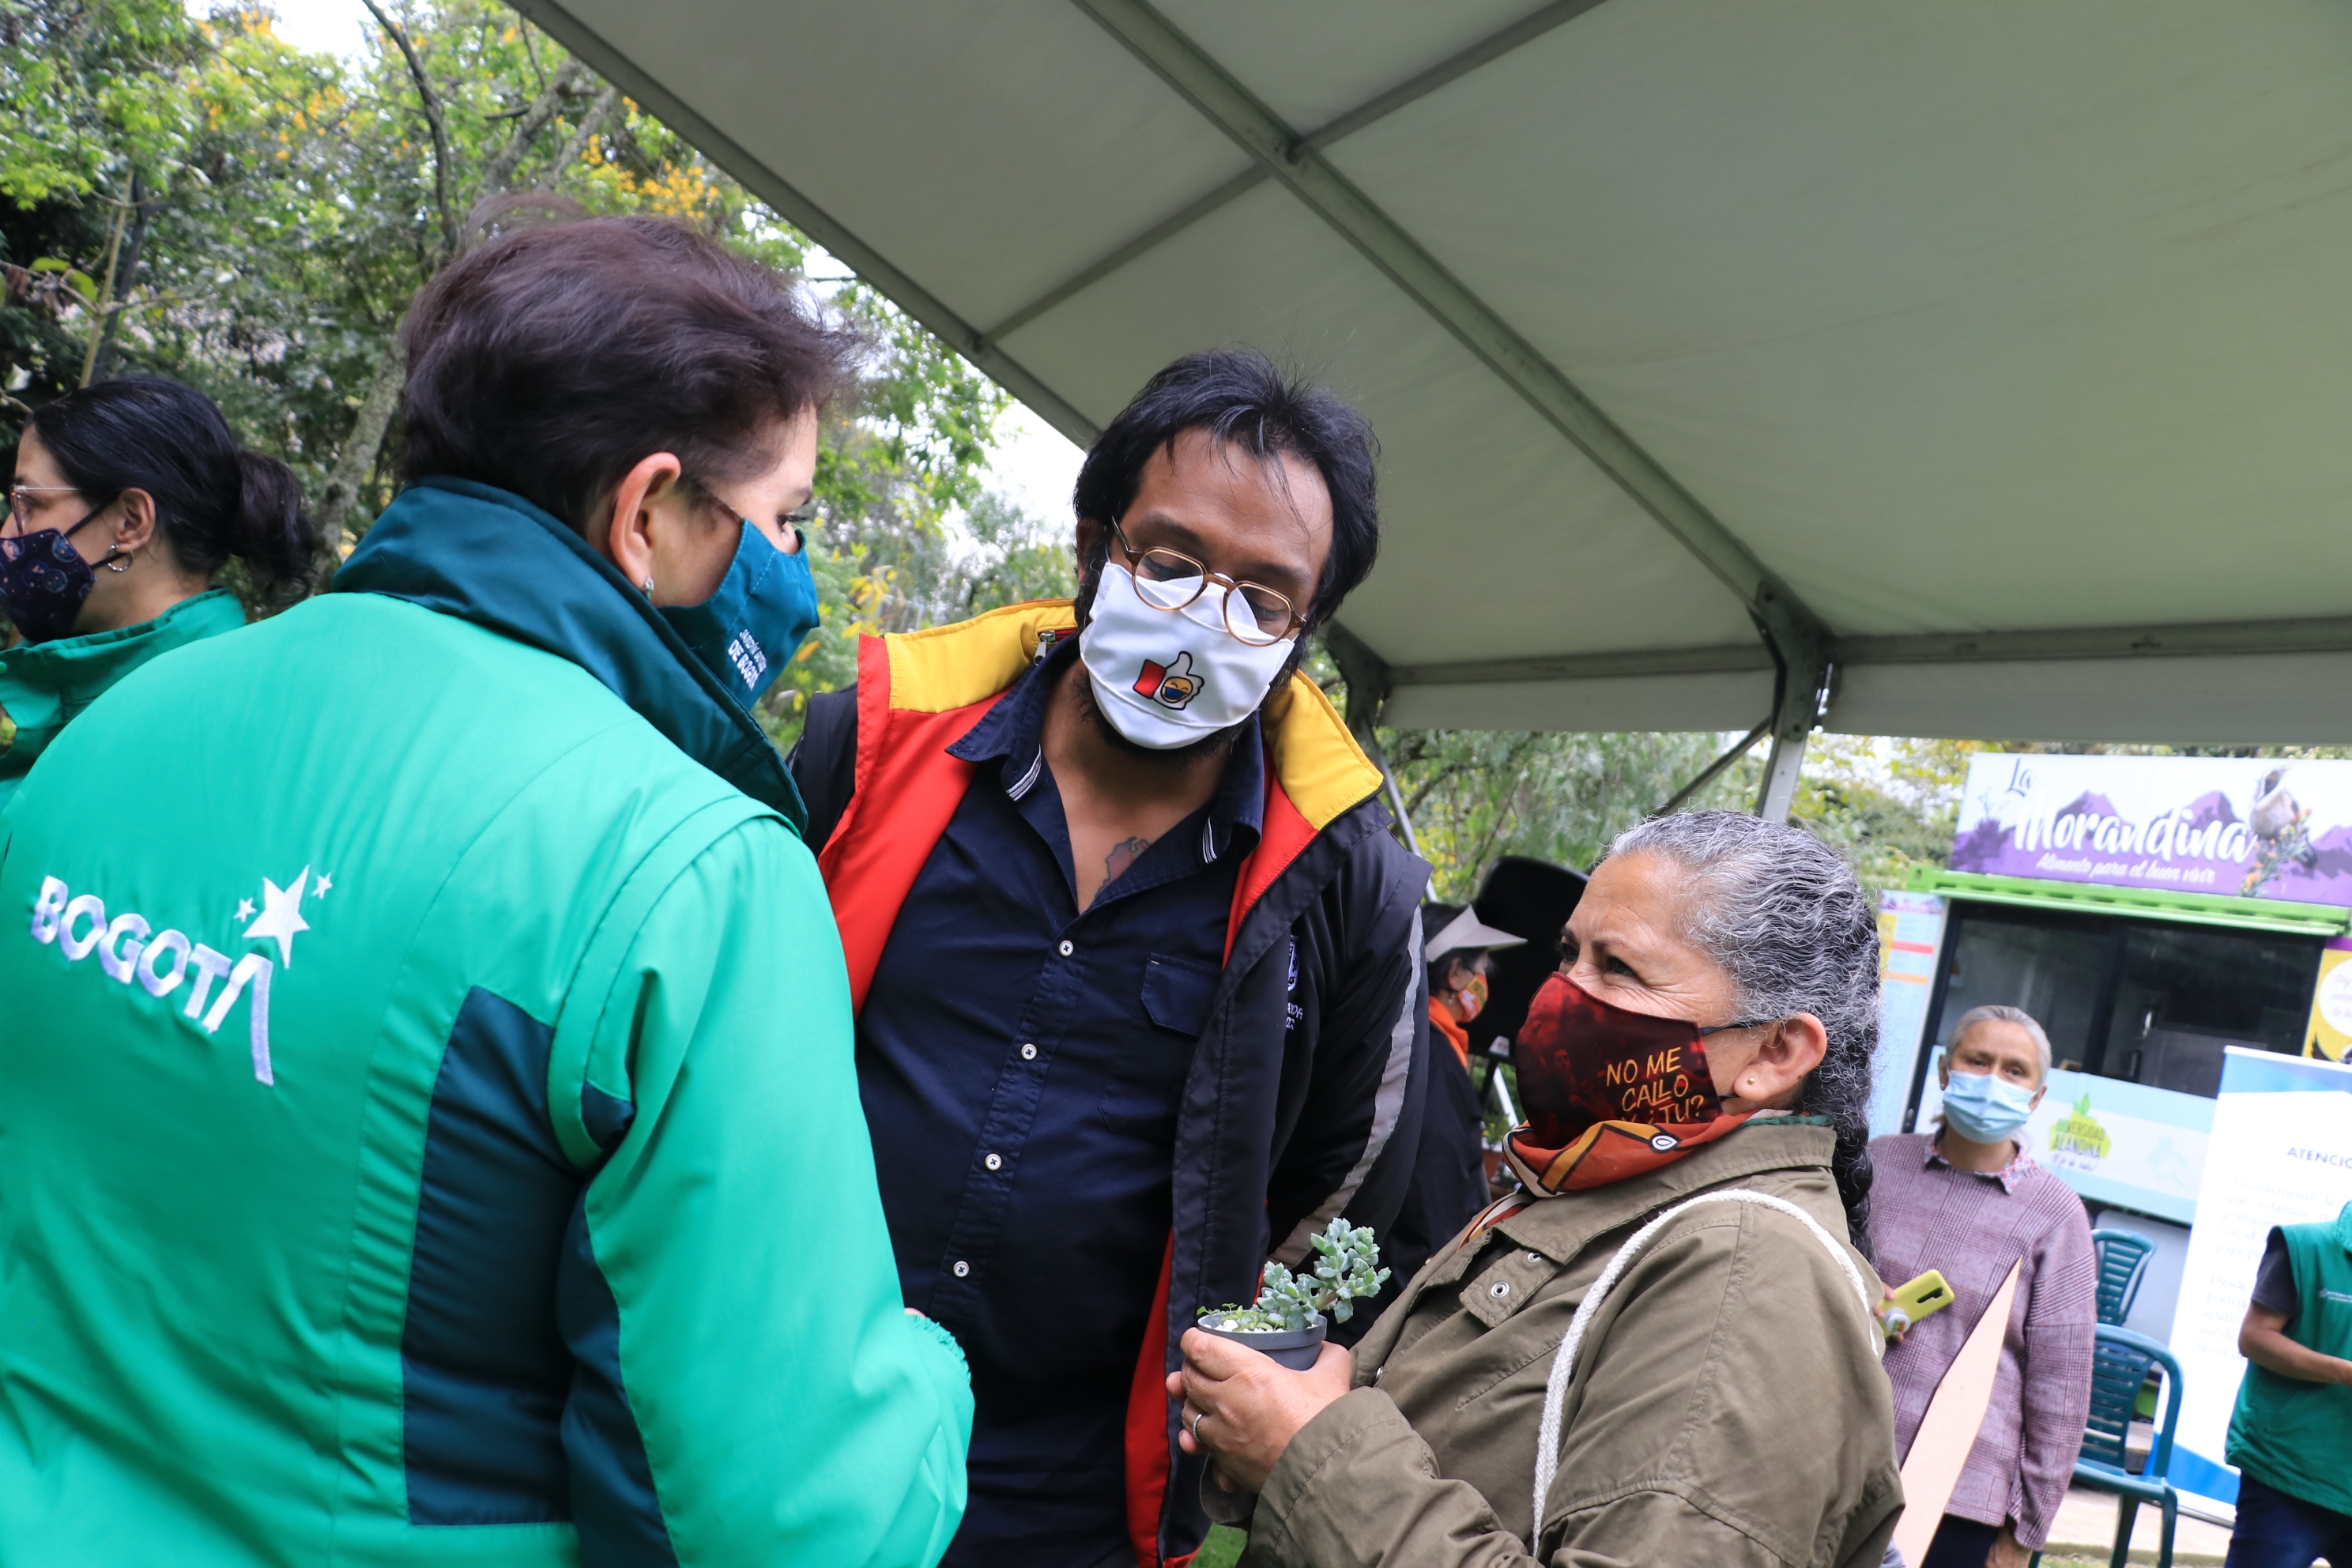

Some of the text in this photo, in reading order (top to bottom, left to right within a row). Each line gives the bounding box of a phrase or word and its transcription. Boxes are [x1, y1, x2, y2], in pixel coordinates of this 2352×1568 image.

[728, 639, 744, 662] DE
[2006, 758, 2033, 797] La
[2014, 797, 2258, 865] Morandina
[2035, 852, 2216, 884] Alimento para el buen vivir
[1607, 1046, 1682, 1087] NO ME
[1623, 1074, 1689, 1112] CALLO
